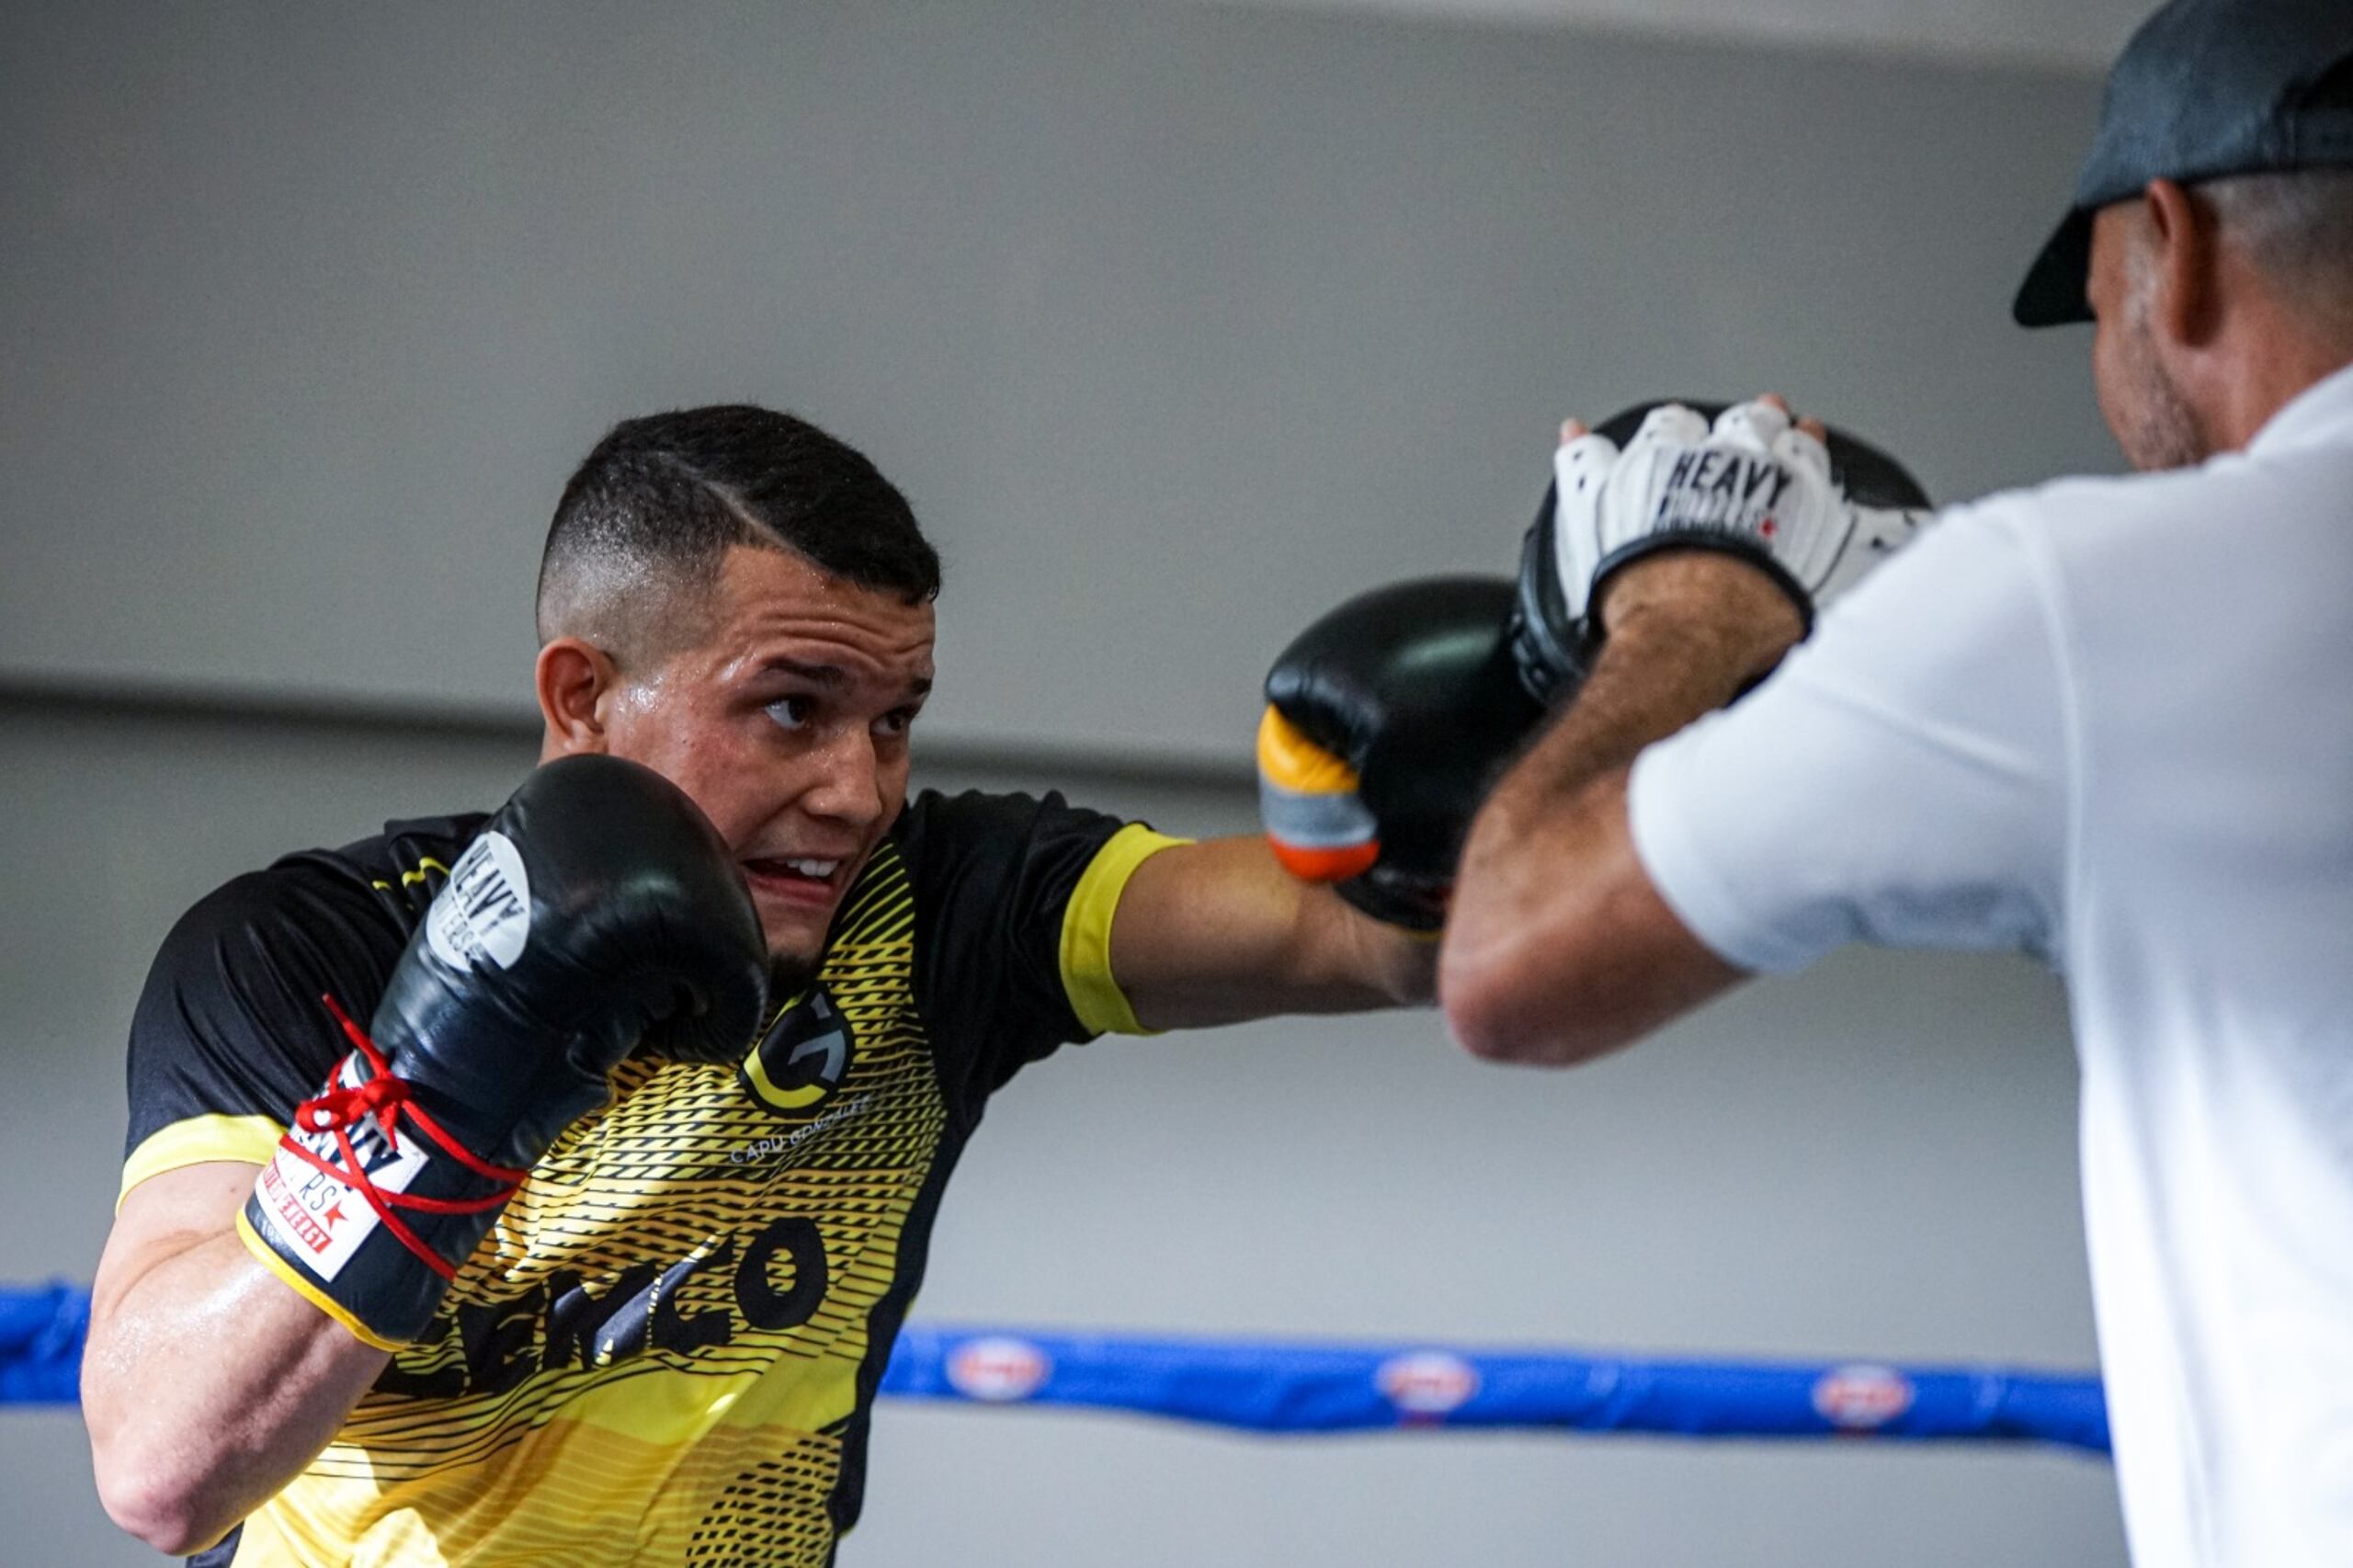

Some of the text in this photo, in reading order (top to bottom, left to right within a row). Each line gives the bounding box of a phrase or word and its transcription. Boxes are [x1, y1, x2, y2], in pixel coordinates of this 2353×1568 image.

[1667, 449, 1791, 509] HEAVY
[451, 839, 527, 937] HEAVY
[730, 1135, 784, 1164] CAPU
